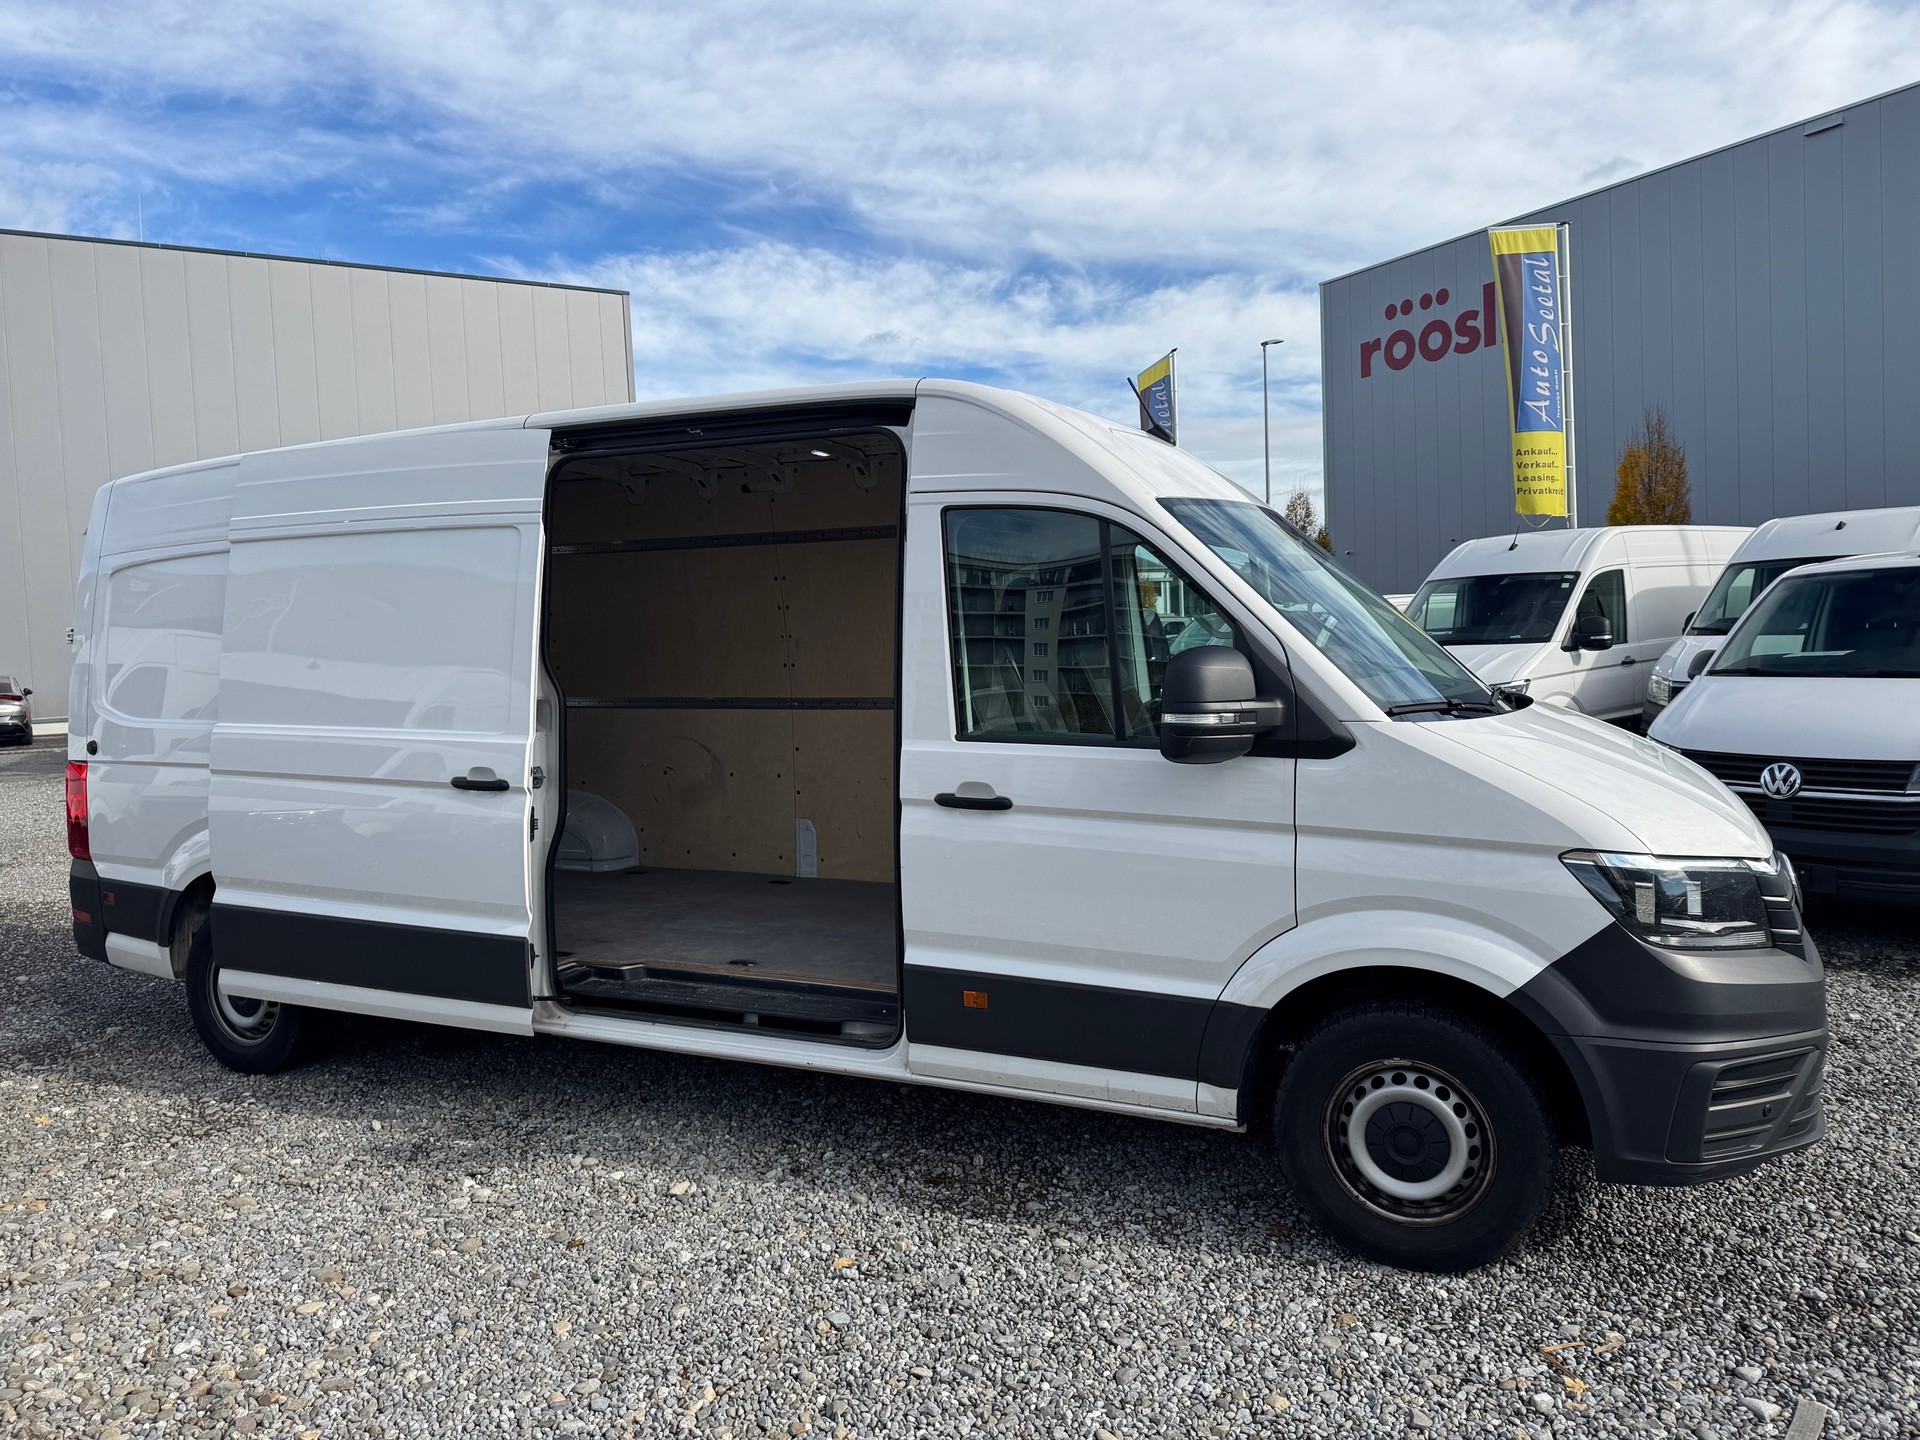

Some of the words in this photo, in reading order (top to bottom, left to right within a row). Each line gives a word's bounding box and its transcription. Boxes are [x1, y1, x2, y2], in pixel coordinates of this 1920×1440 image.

[1360, 281, 1504, 379] röösl
[1523, 257, 1560, 353] Seetal
[1523, 350, 1557, 429] Auto
[1761, 762, 1800, 799] VW
